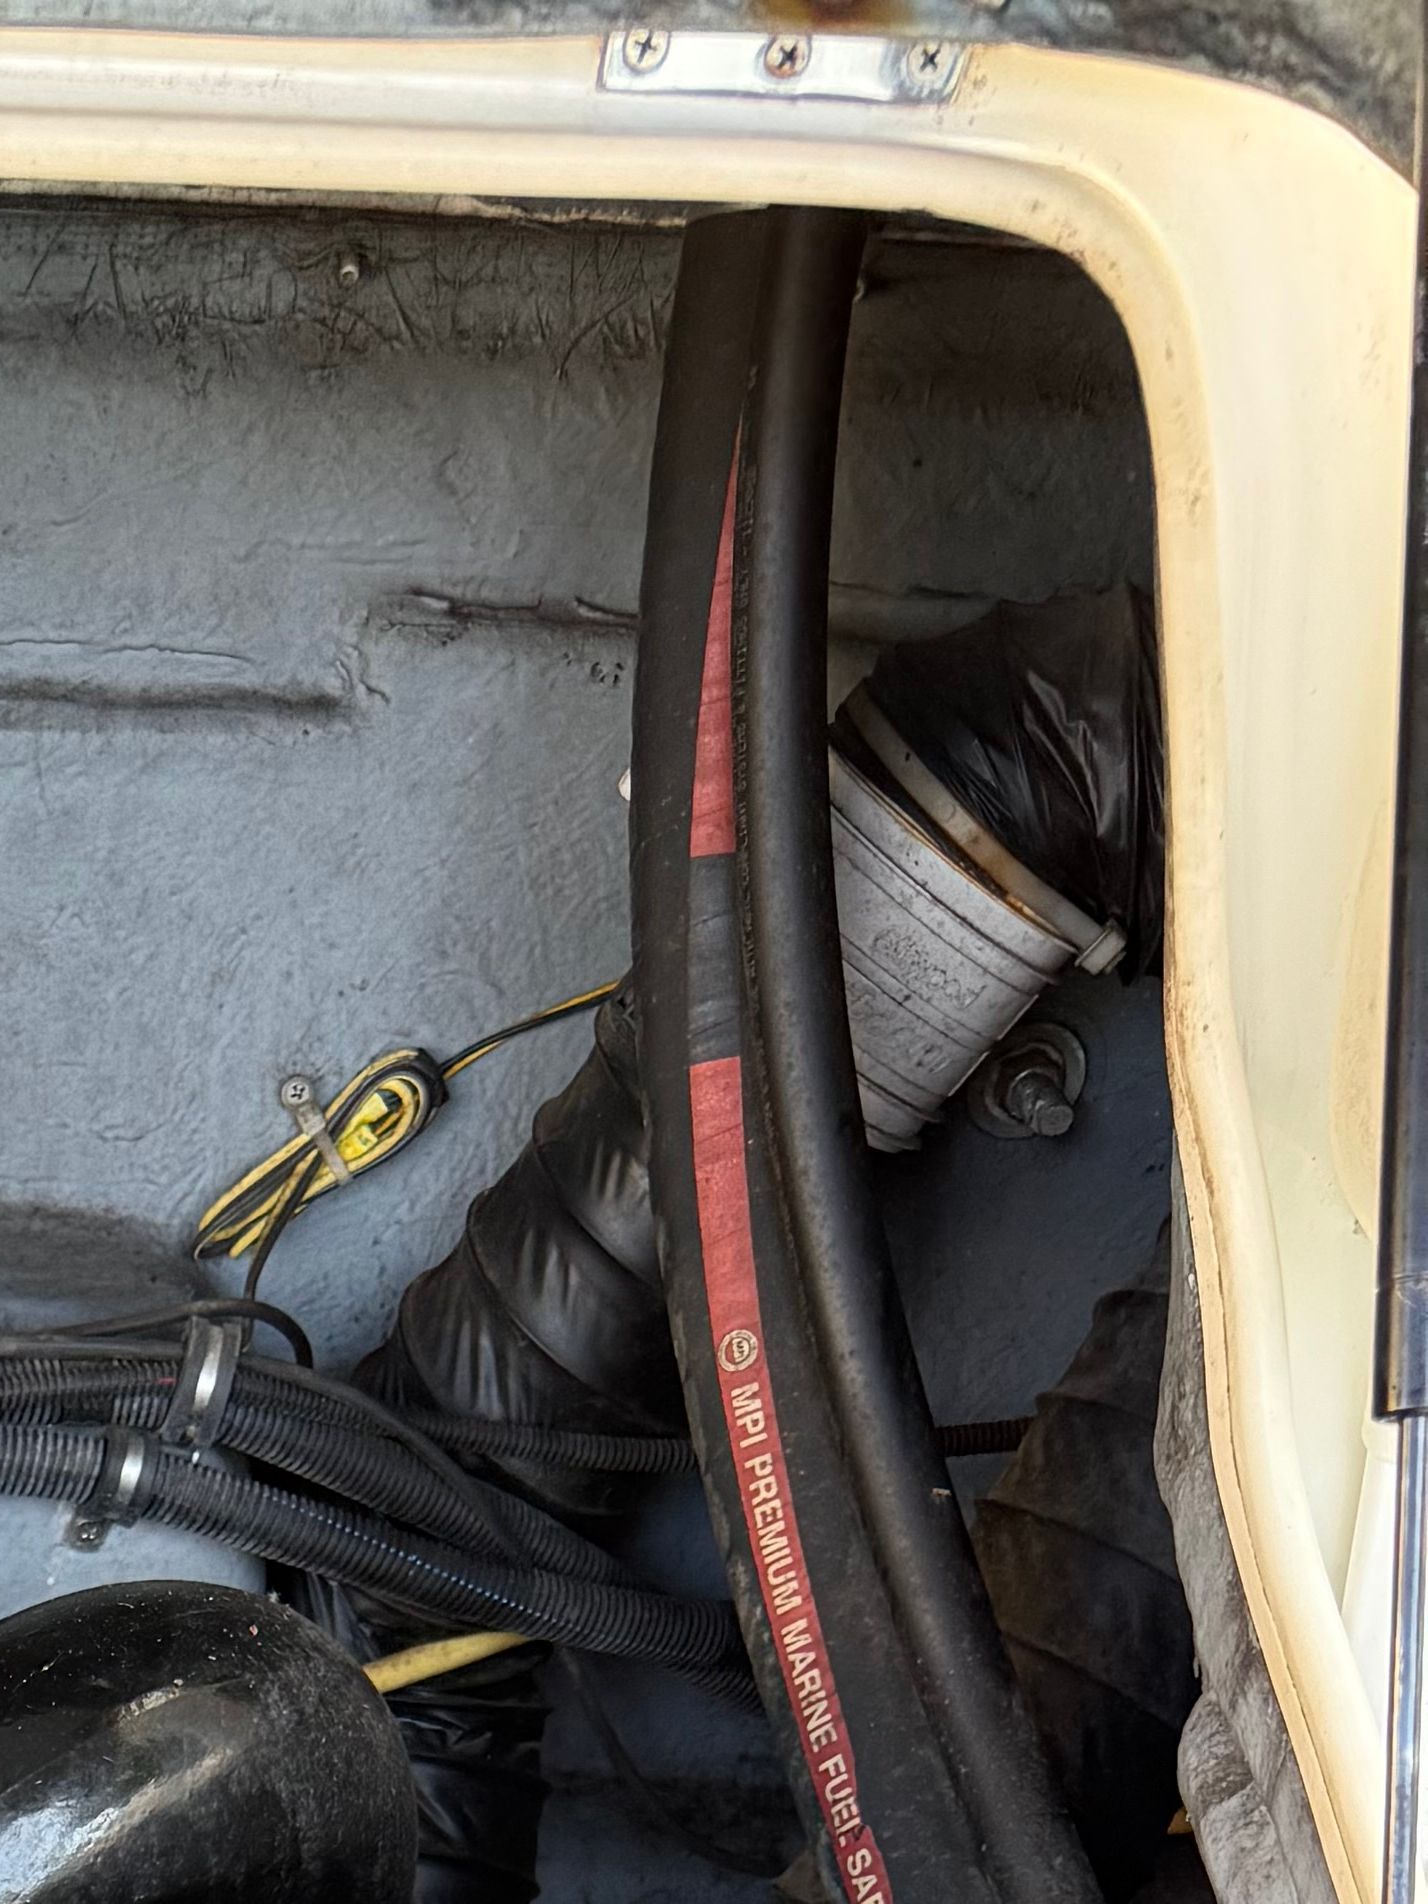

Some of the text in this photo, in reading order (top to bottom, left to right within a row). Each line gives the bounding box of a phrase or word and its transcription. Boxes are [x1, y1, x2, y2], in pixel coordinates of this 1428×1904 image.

[730, 1382, 768, 1449] MPI
[744, 1452, 803, 1615] PREMIUM
[781, 1618, 838, 1755] MARINE
